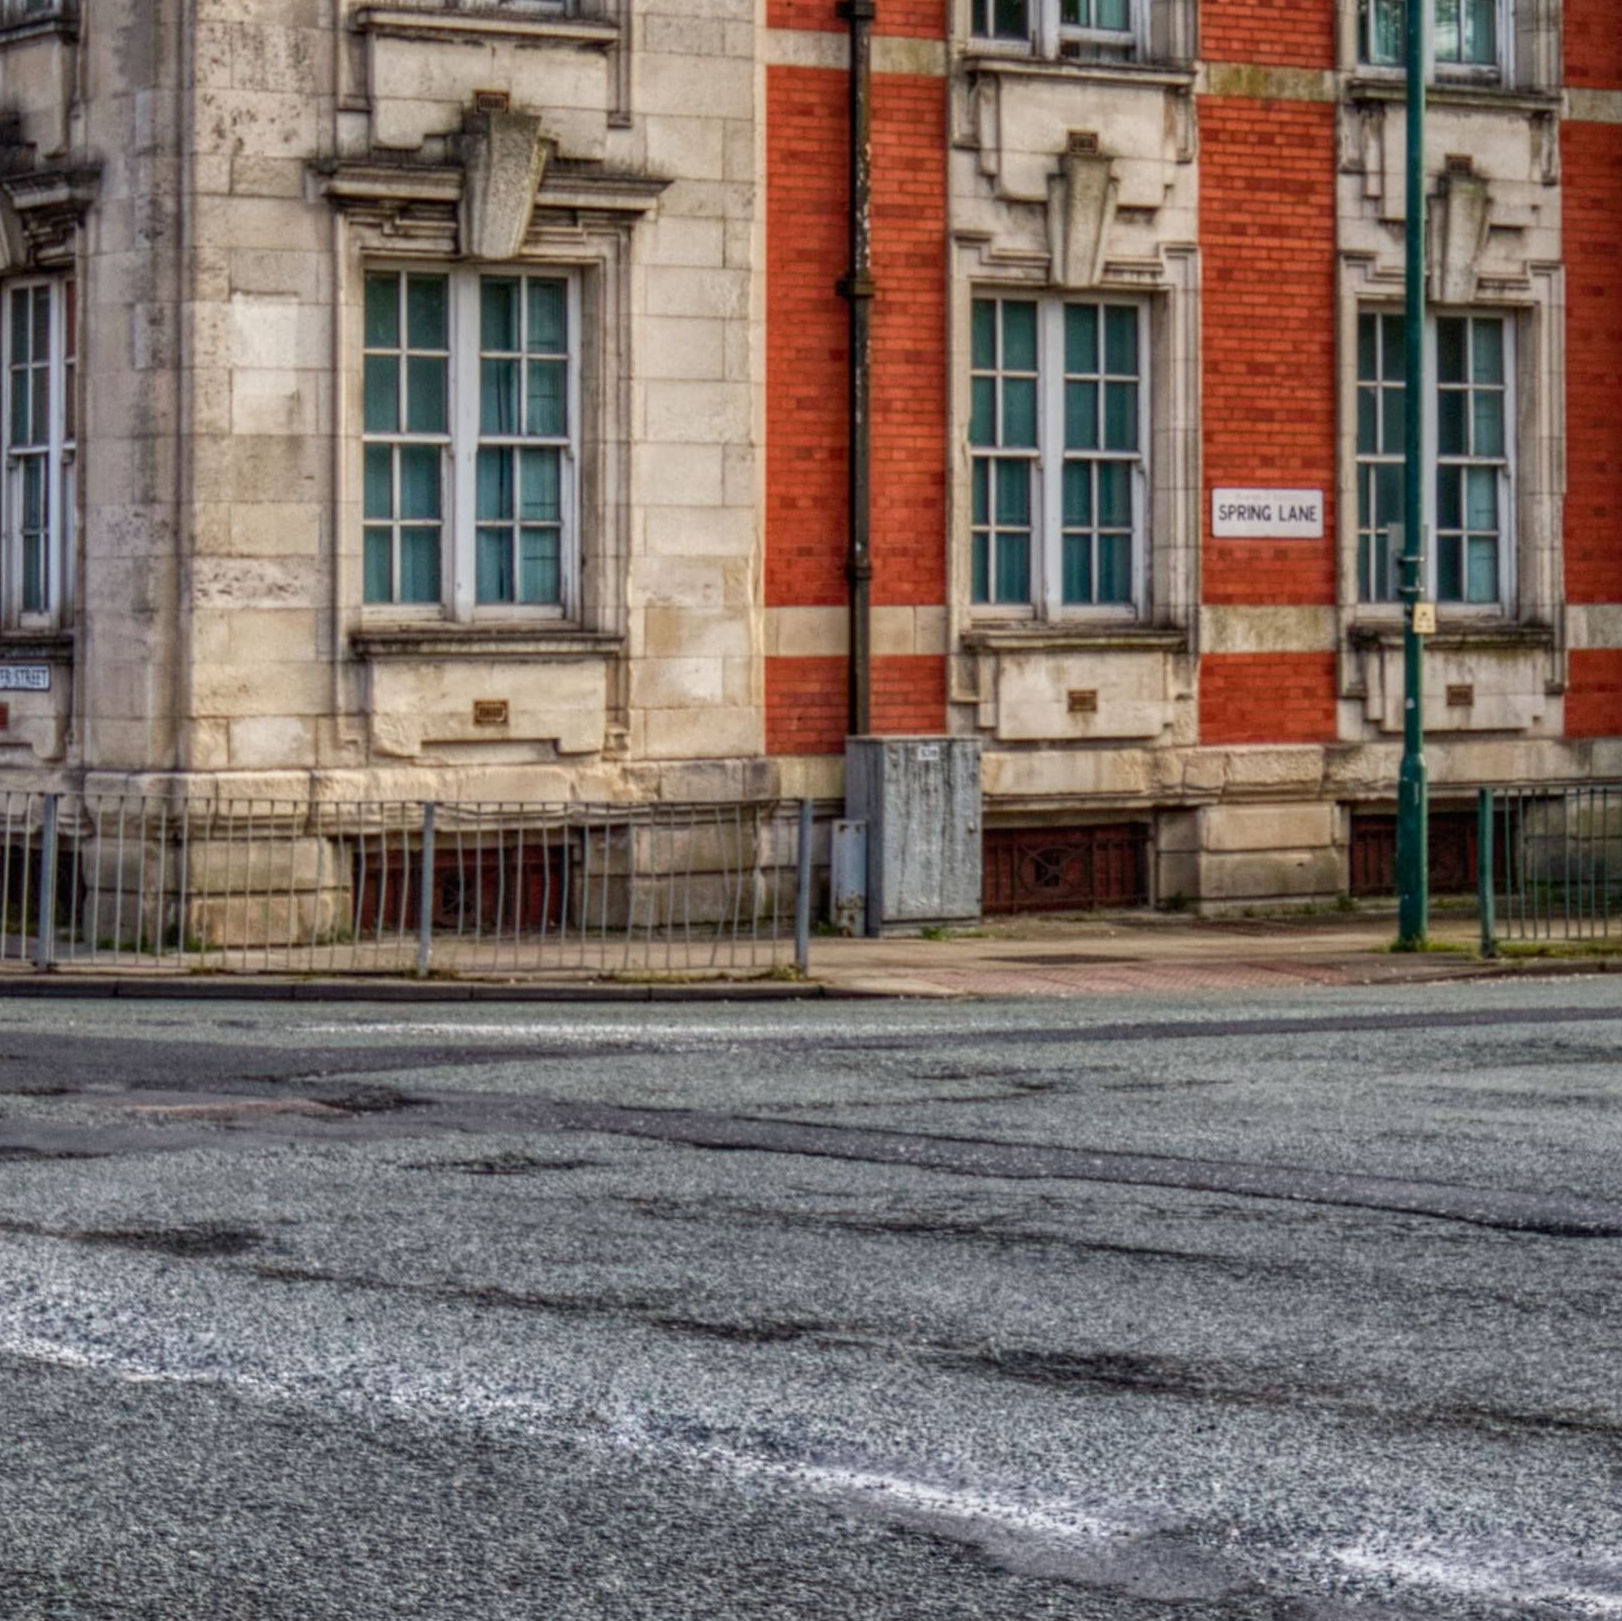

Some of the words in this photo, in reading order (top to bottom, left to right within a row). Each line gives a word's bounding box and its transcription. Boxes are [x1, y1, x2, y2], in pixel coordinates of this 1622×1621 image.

[1219, 504, 1271, 521] SPRING
[1279, 504, 1317, 522] LANE
[15, 669, 46, 685] STREET
